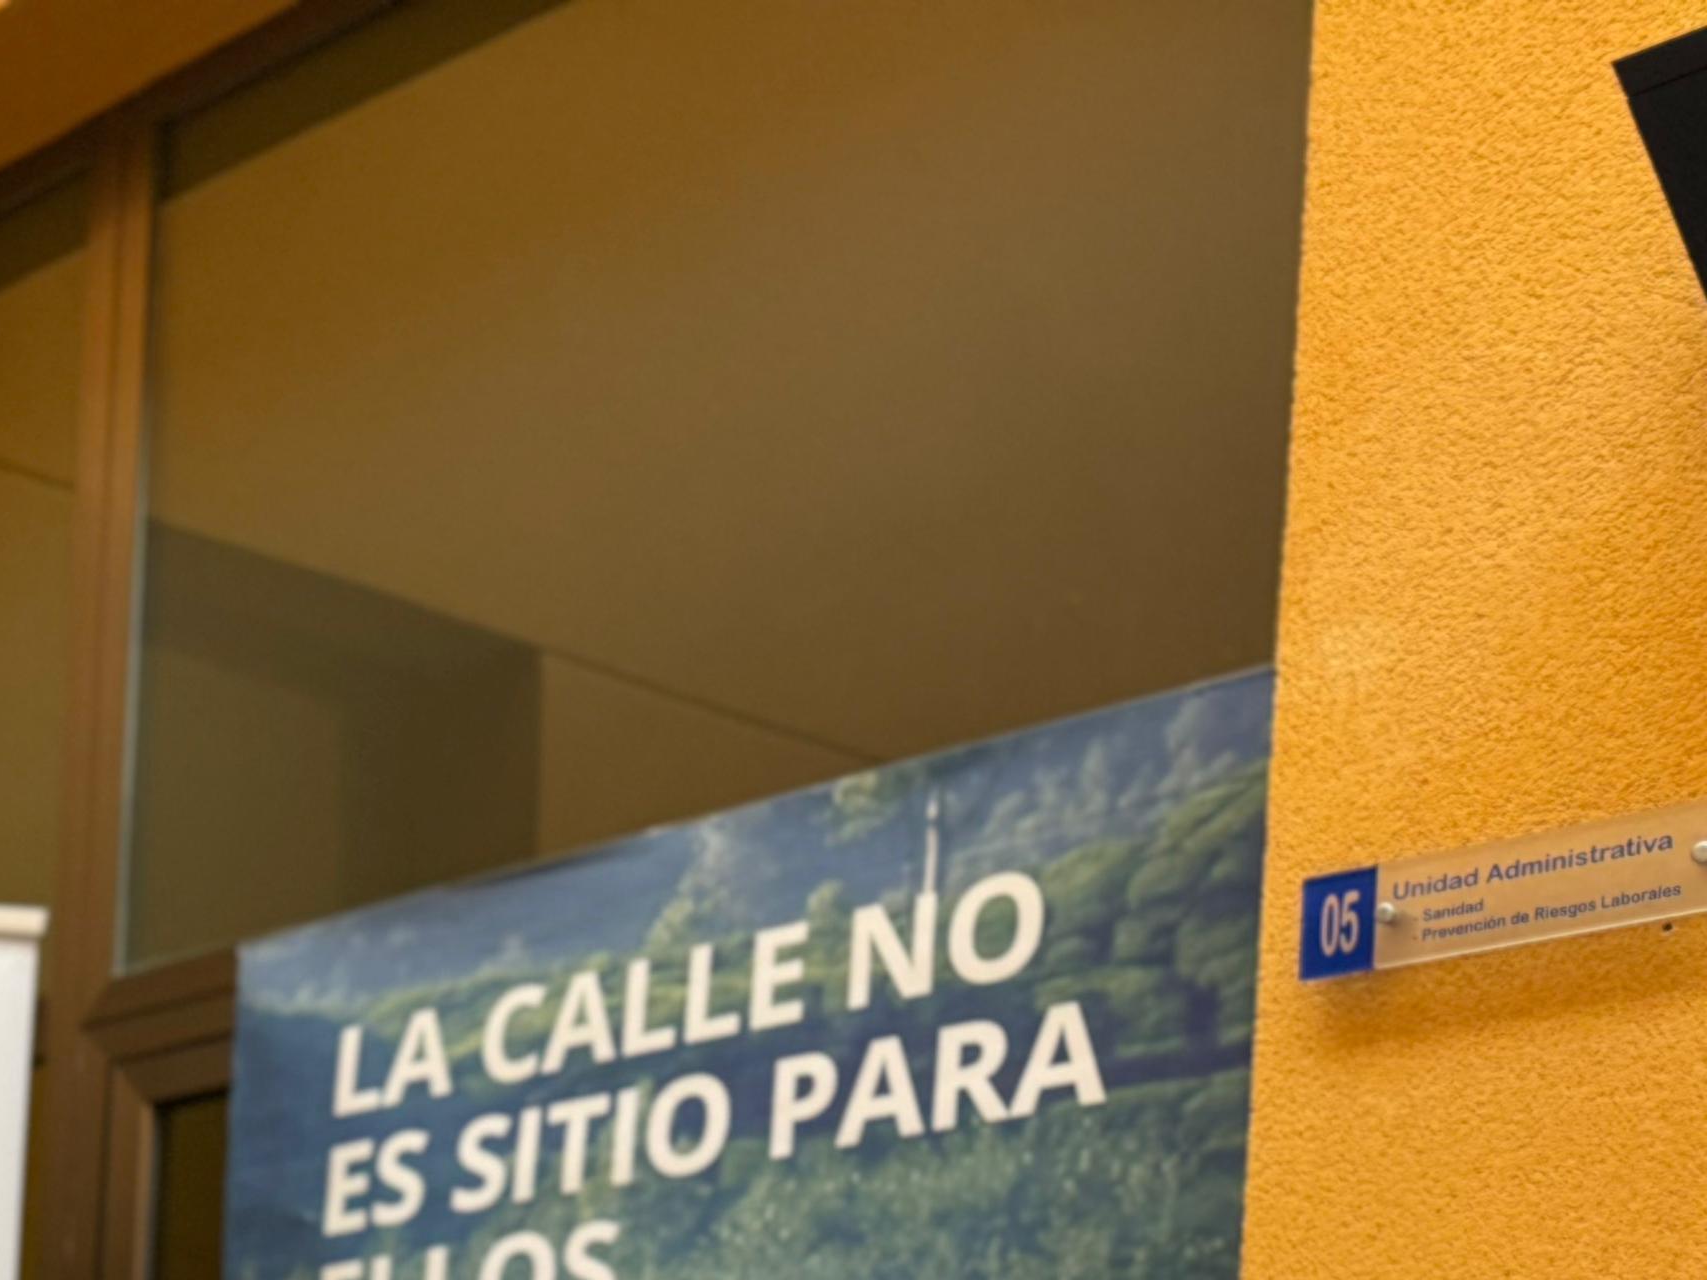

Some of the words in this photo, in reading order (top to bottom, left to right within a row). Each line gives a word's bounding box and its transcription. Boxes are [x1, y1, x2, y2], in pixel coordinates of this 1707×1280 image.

[1392, 867, 1479, 900] Unidad
[1486, 834, 1674, 884] Administrativa
[1319, 890, 1361, 957] 05
[1421, 915, 1506, 942] Prevención
[1510, 912, 1530, 926] de
[1534, 900, 1597, 921] Riesgos
[1600, 884, 1683, 909] Laborales
[1422, 898, 1484, 922] Sanidad
[331, 1008, 452, 1118] LA
[479, 922, 809, 1082] CALLE
[845, 872, 1045, 1010] NO
[322, 1130, 429, 1238] ES
[449, 1073, 732, 1214] SITIO
[769, 1002, 1107, 1160] PARA
